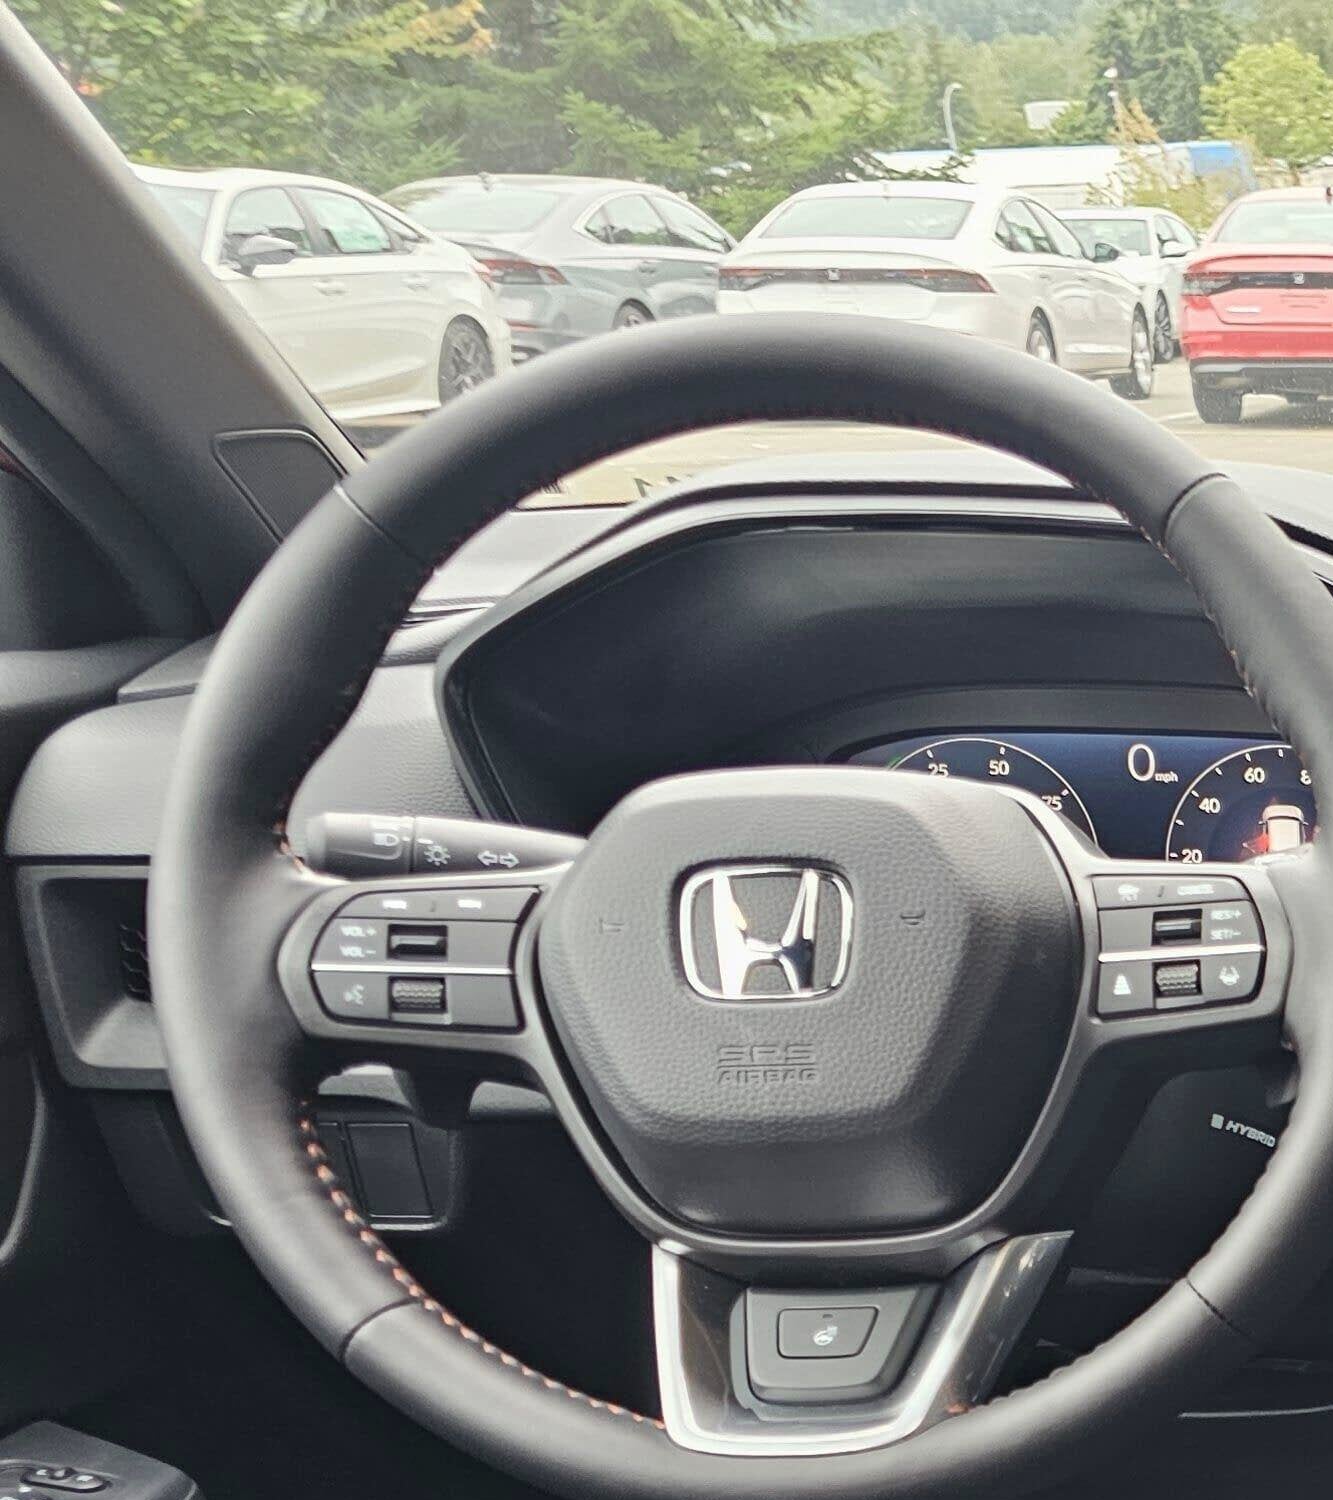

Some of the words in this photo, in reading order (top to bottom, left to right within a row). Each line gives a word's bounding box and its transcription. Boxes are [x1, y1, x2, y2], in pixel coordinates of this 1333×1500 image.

[928, 763, 950, 778] 25
[988, 759, 1011, 777] 50
[1127, 742, 1157, 784] 0
[1154, 771, 1179, 786] mph
[1243, 767, 1266, 784] 60
[1198, 797, 1221, 814] 40
[1181, 848, 1203, 865] 20
[1225, 1119, 1276, 1149] HYBRID
